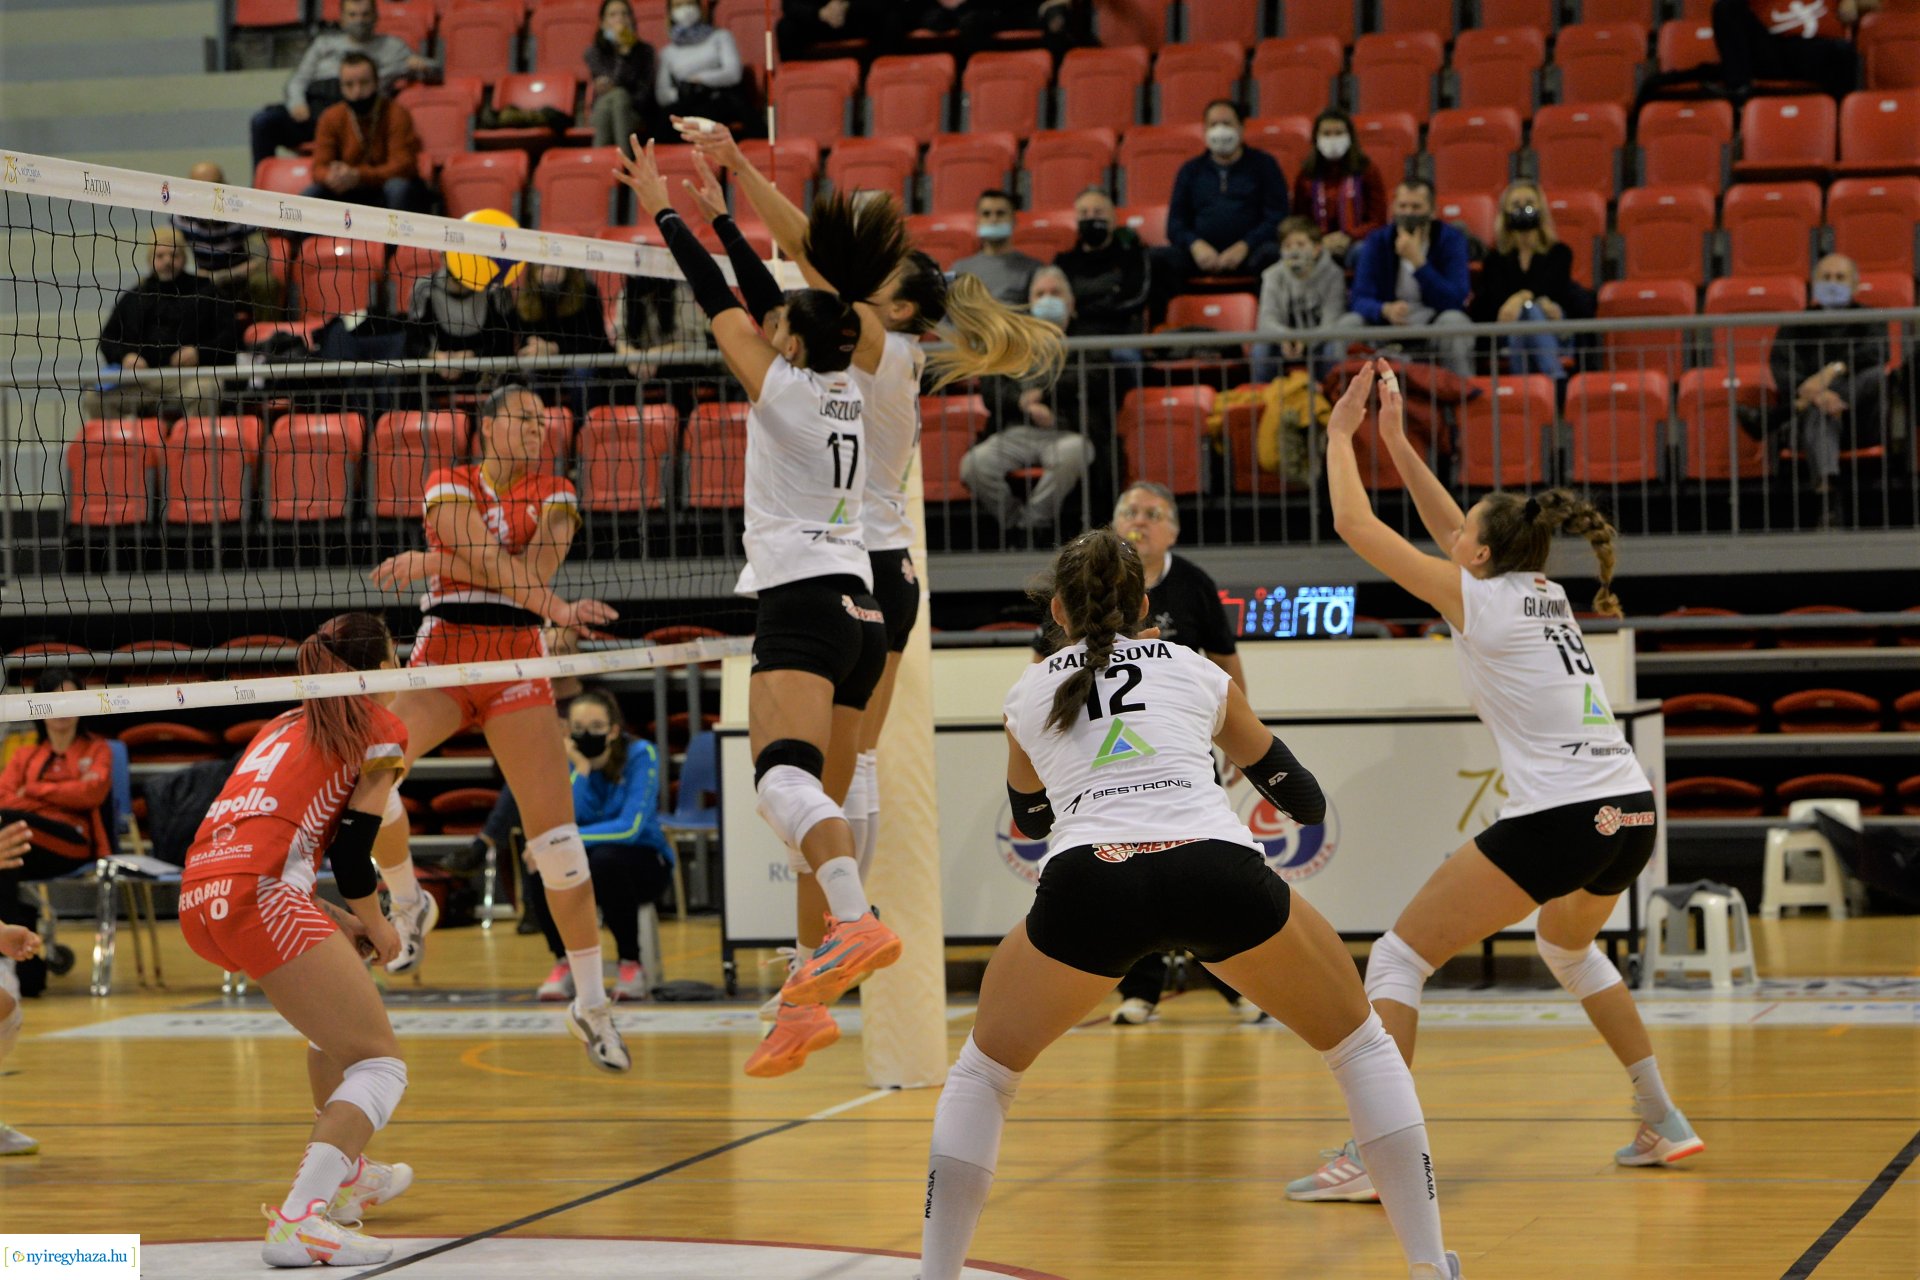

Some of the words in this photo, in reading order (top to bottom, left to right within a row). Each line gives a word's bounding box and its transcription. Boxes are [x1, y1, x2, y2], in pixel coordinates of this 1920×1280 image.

[83, 171, 111, 194] FATUM
[828, 432, 858, 490] 17
[1300, 599, 1350, 635] 10
[1048, 643, 1173, 674] RASOVA
[1544, 624, 1595, 675] 19
[1087, 663, 1146, 721] 12
[236, 721, 297, 782] 4
[205, 787, 278, 823] apollo
[1092, 780, 1192, 800] BESTRONG
